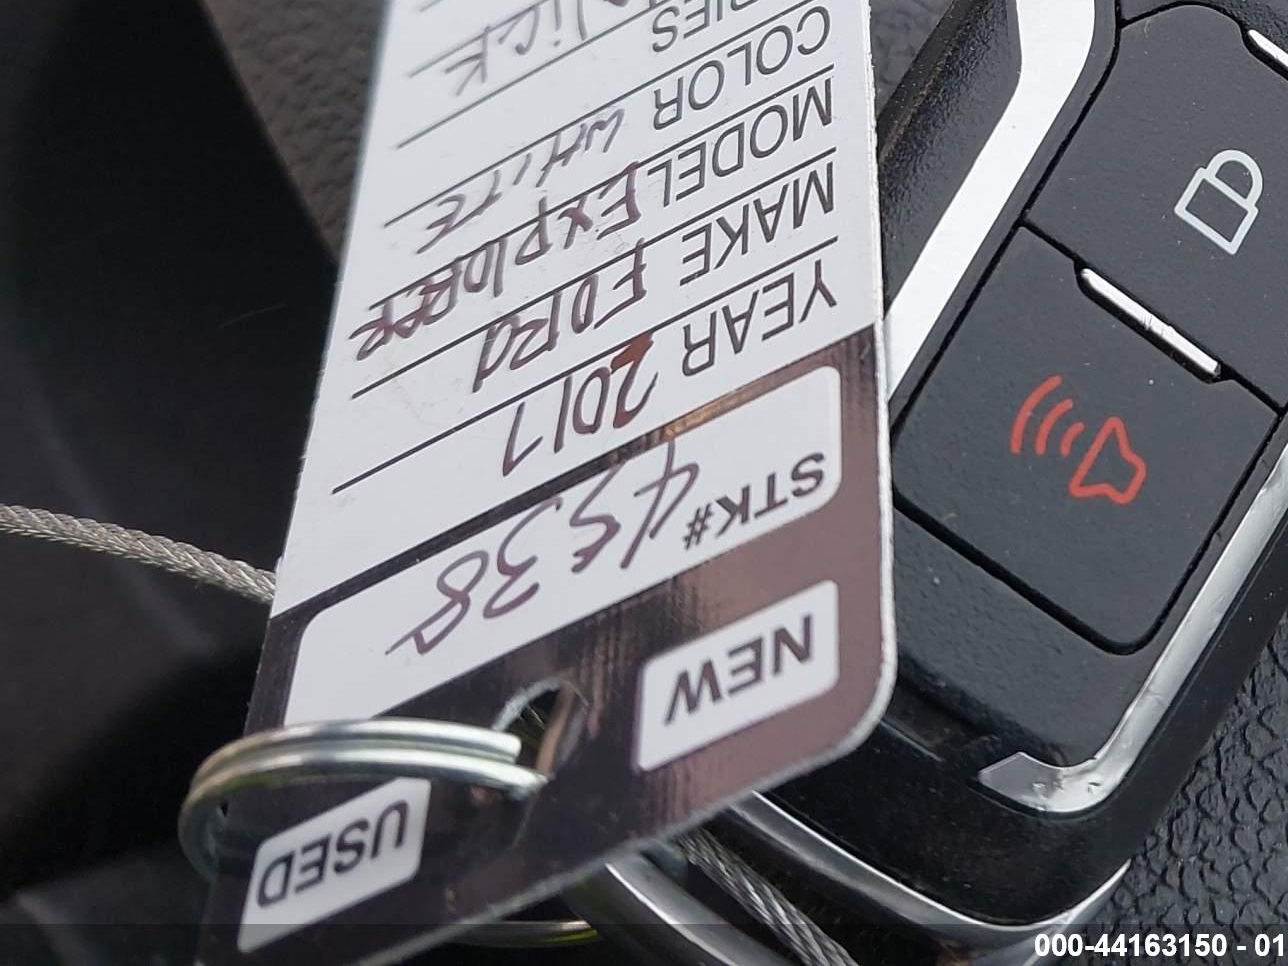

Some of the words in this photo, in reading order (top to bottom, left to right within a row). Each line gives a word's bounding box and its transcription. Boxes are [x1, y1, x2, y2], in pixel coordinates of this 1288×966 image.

[652, 6, 831, 131] COLOR
[647, 78, 833, 207] MODEL
[680, 162, 835, 287] MAKE
[682, 259, 837, 377] YEAR
[502, 334, 659, 478] 2017
[683, 452, 825, 550] STK#
[664, 613, 813, 726] NEW
[256, 800, 411, 910] USED
